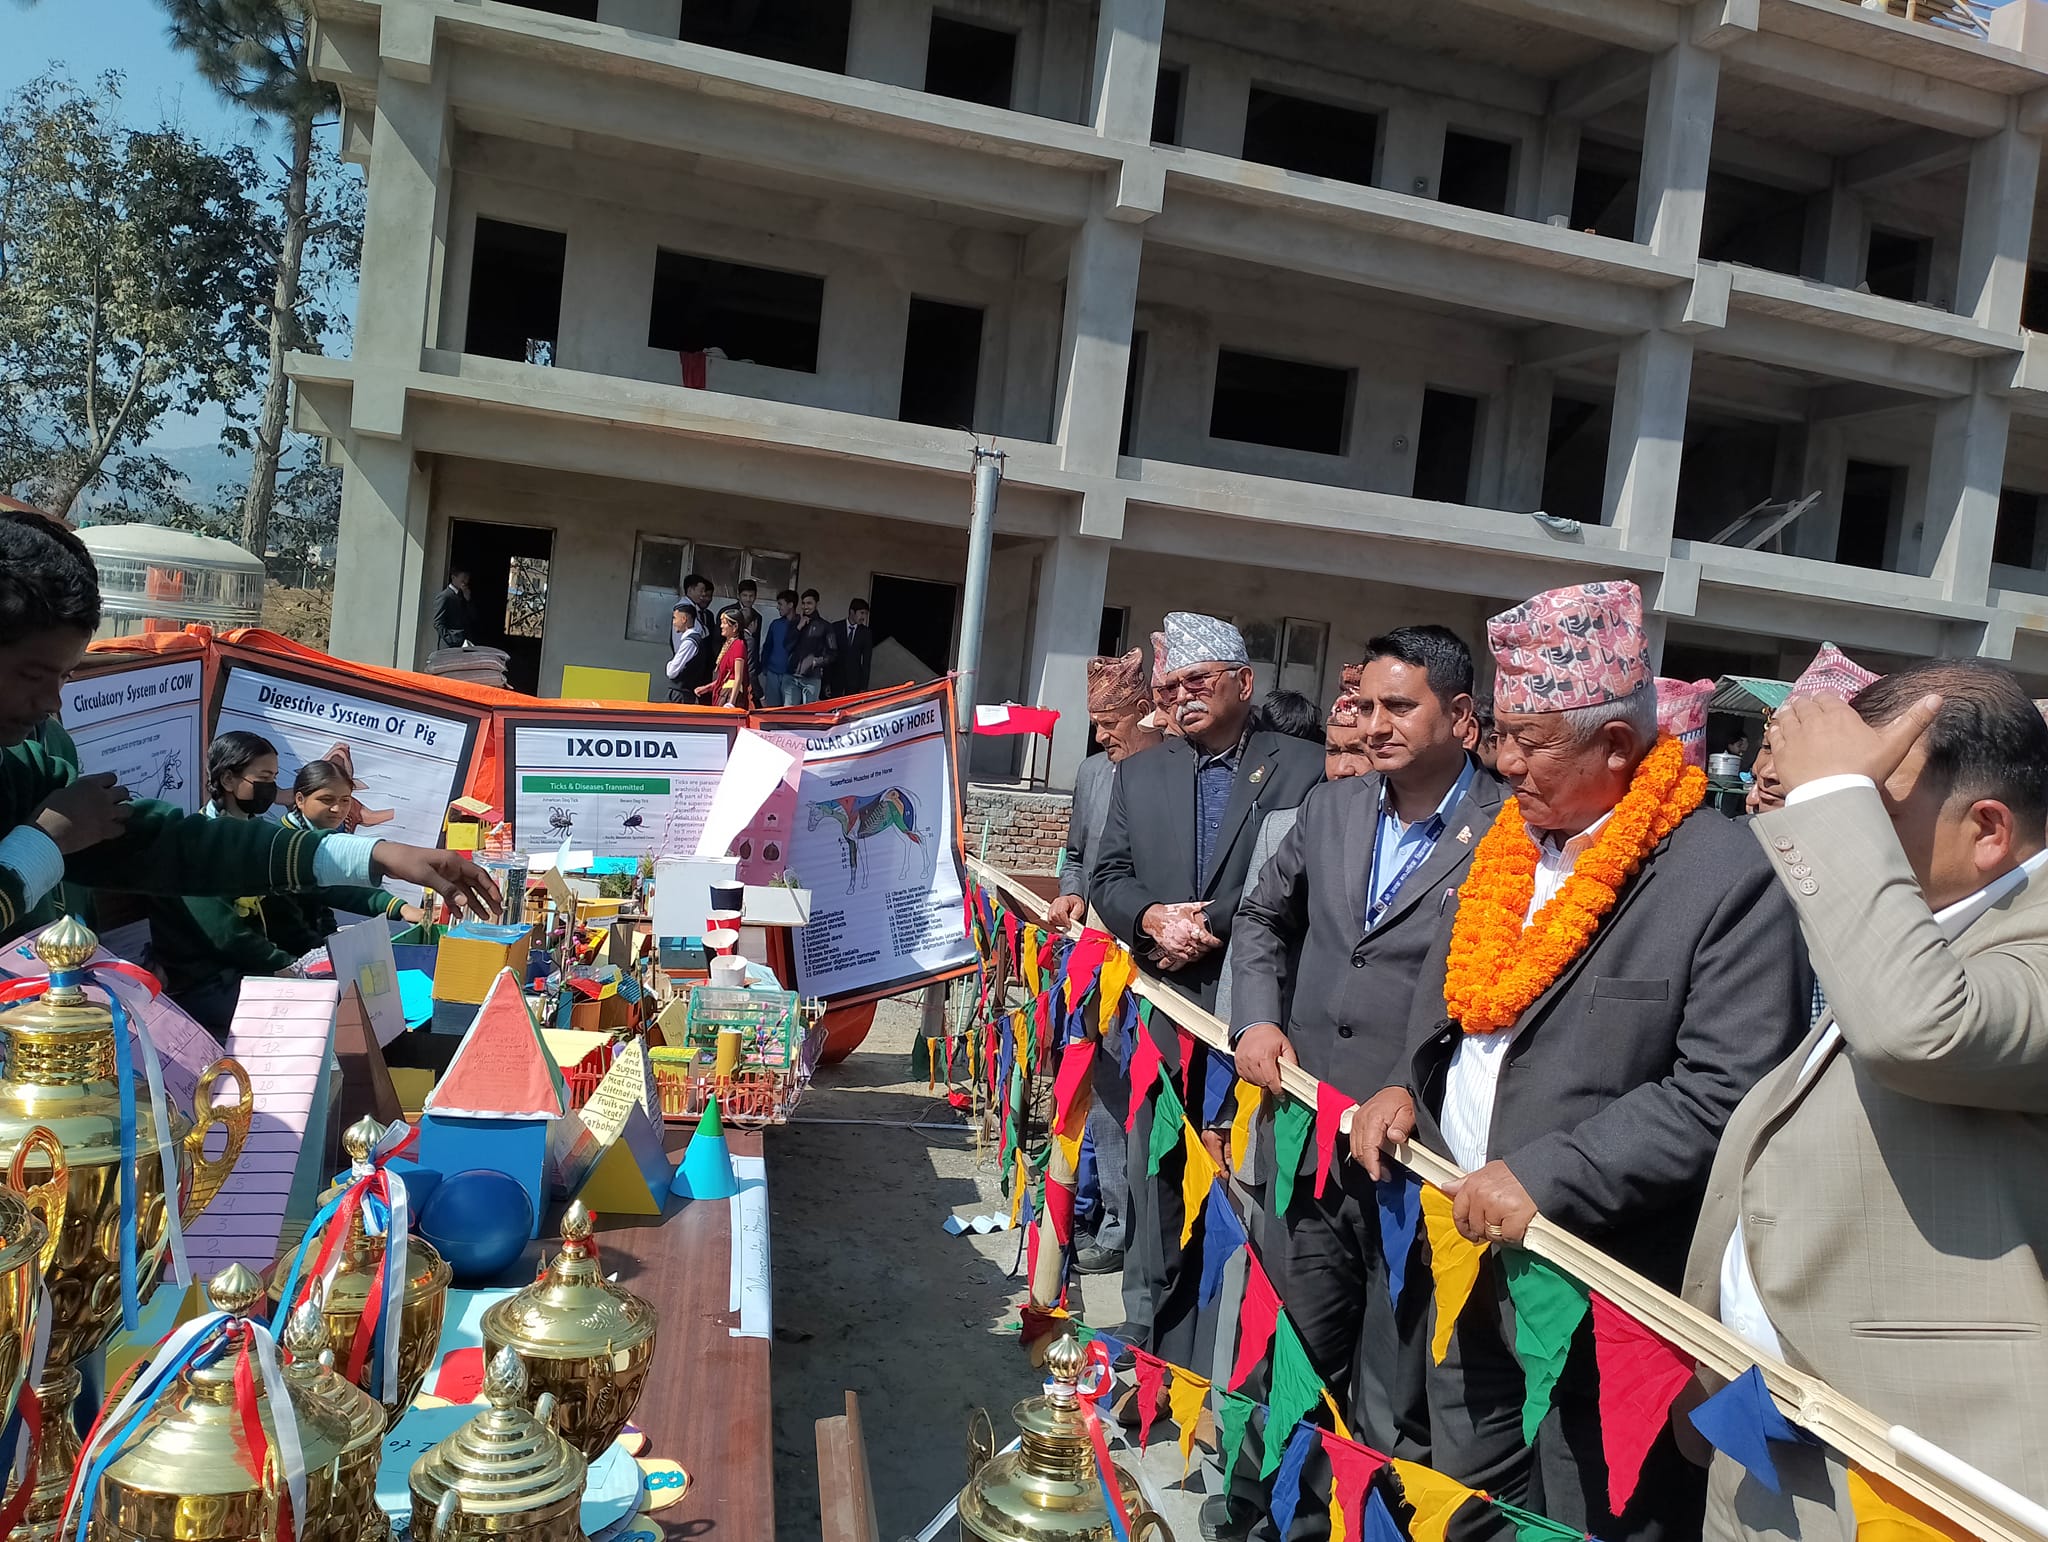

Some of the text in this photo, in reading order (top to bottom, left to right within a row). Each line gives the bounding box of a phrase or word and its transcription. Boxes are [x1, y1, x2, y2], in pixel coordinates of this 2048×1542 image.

[74, 673, 193, 712] Circulatory System of COW
[258, 685, 436, 745] Digestive System Of Pig
[806, 710, 935, 750] CULAR SYSTEM OF HORSE
[567, 738, 678, 758] IXODIDA
[276, 987, 295, 999] 15
[268, 1023, 284, 1035] 13
[262, 1041, 280, 1054] 12
[258, 1080, 274, 1091] 10
[603, 1109, 623, 1119] veget
[252, 1117, 261, 1130] 8
[240, 1157, 250, 1169] 6
[235, 1177, 245, 1189] 5
[226, 1197, 235, 1210] 4
[216, 1216, 227, 1231] 3
[207, 1238, 220, 1254] 2
[643, 1471, 685, 1490] 8
